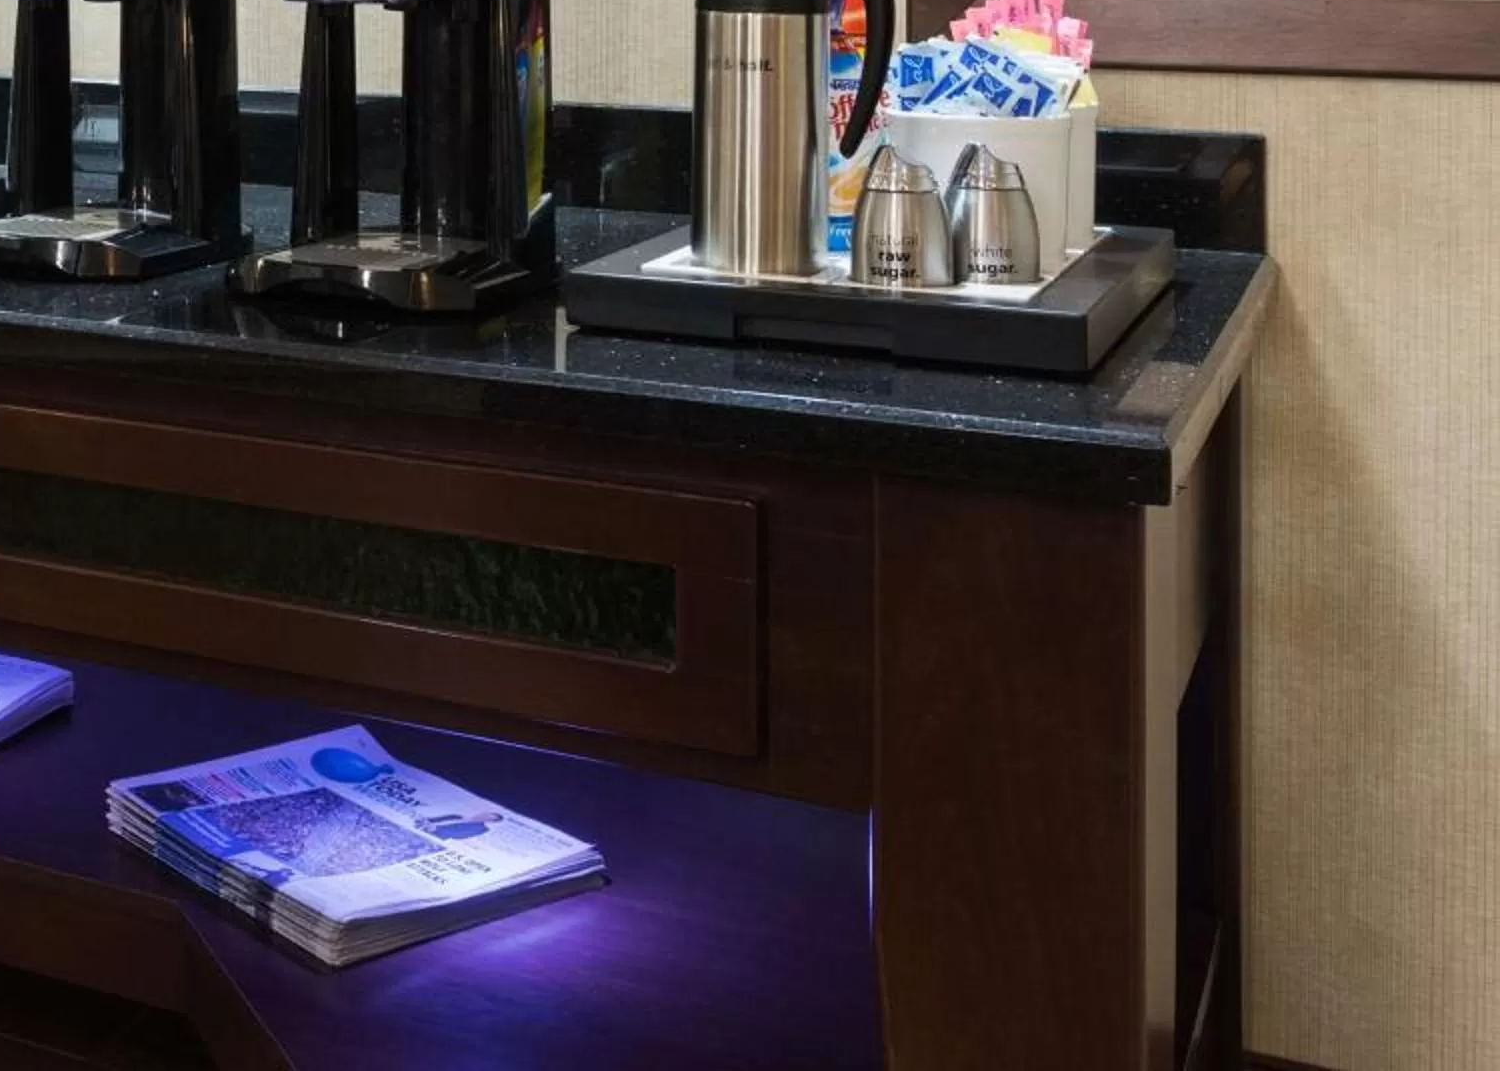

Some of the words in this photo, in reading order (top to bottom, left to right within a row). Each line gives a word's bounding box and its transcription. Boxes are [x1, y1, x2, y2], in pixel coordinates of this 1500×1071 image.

[878, 252, 911, 262] raw
[870, 266, 921, 280] sugar.
[966, 263, 1020, 277] sugar.
